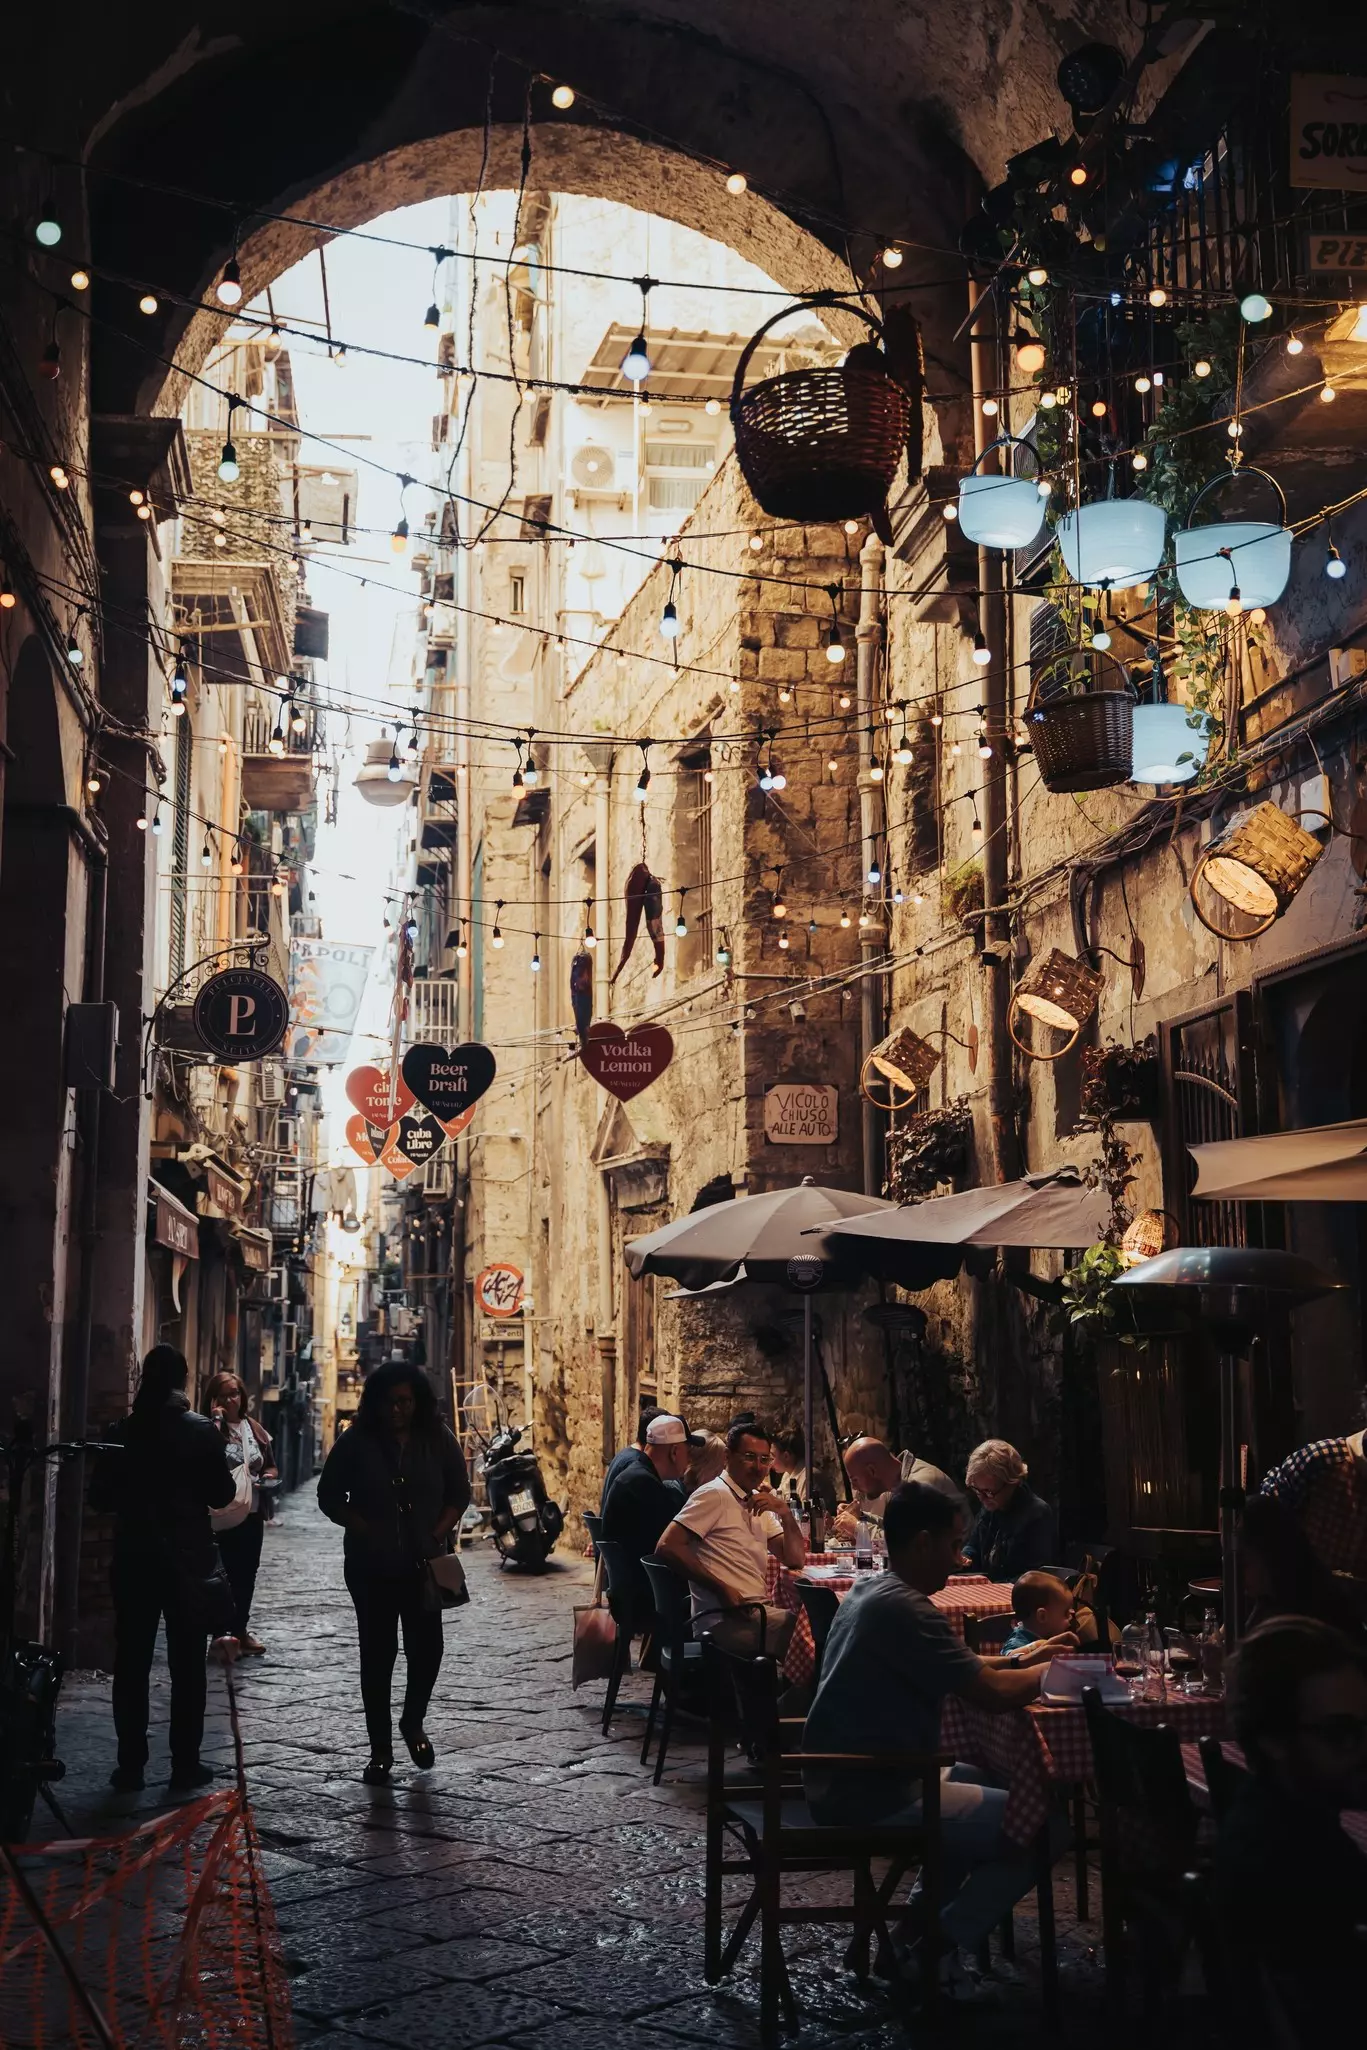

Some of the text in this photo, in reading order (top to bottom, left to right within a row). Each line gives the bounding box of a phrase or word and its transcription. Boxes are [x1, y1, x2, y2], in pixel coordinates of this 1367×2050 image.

[208, 975, 277, 1001] PULCINELLA
[222, 1042, 258, 1055] SUITE
[601, 1042, 652, 1057] Vodka
[430, 1063, 468, 1076] Beer
[600, 1061, 652, 1073] Lemon
[428, 1076, 468, 1092] Draft
[366, 1096, 402, 1107] Tonc
[773, 1093, 829, 1109] VICOLO
[781, 1109, 828, 1122] CHIUSO
[406, 1128, 432, 1139] Cuba
[771, 1122, 831, 1137] ALLE AUTO
[406, 1139, 433, 1150] Libre
